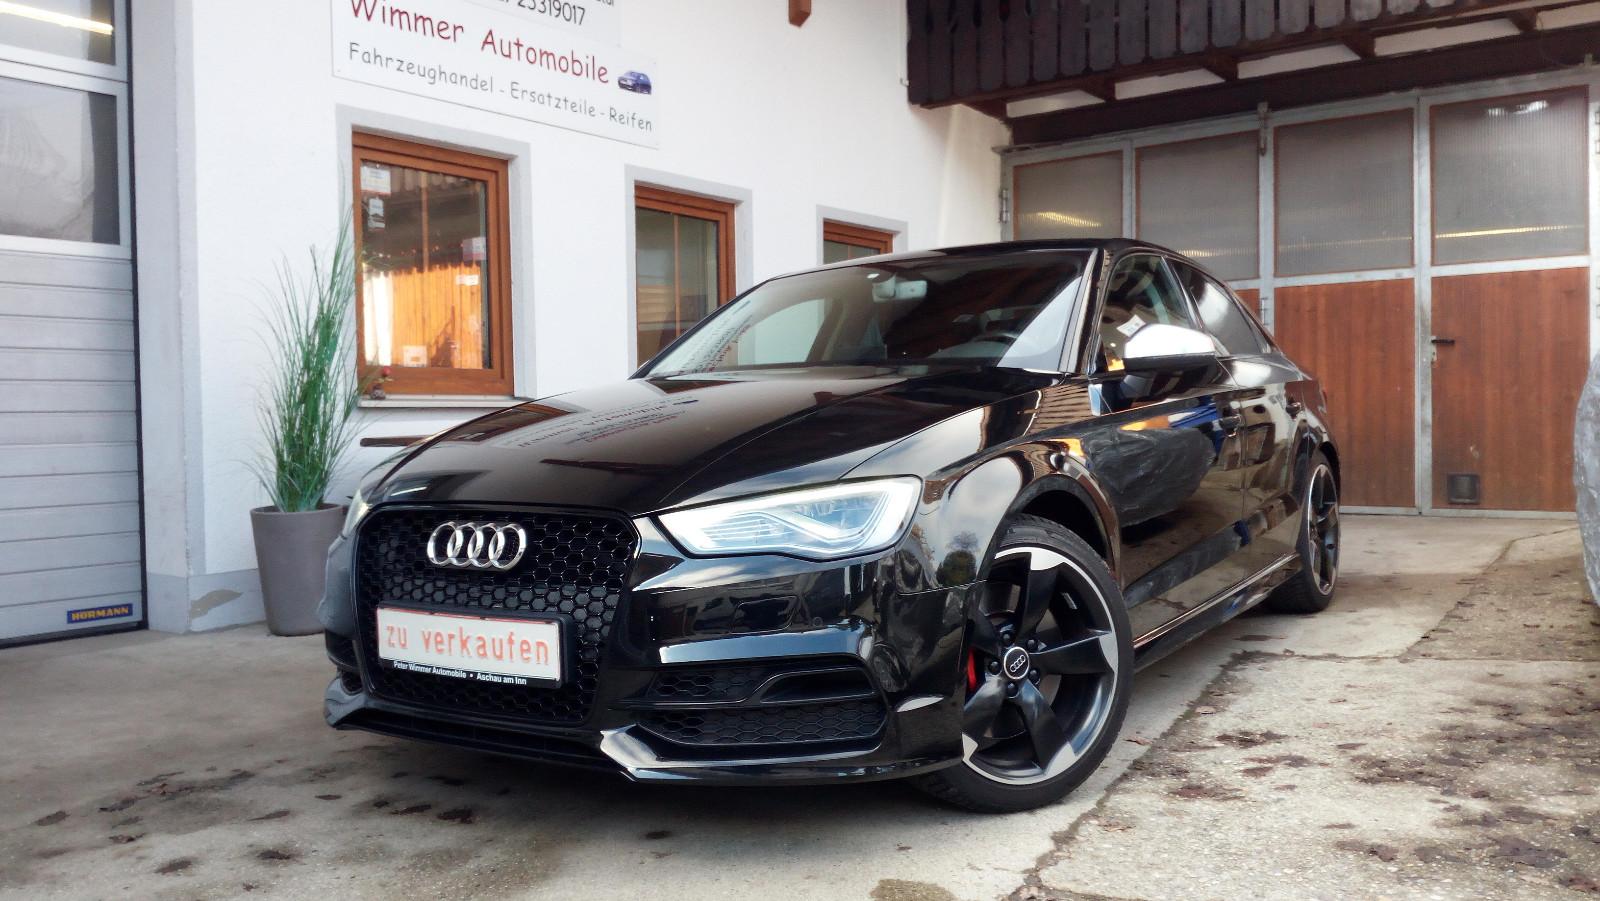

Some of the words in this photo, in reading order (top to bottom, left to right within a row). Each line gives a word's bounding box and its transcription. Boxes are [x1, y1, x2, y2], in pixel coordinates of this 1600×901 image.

[351, 0, 464, 42] Wimmer
[481, 29, 609, 84] Automobile
[349, 42, 493, 93] Fahrzeughandel
[510, 81, 596, 117] Ersatzteile
[609, 106, 652, 132] Reifen
[386, 624, 408, 650] zu
[421, 626, 550, 666] verkaufen
[393, 660, 408, 670] Peter
[409, 663, 432, 674] Wimmer
[432, 666, 467, 679] Automobile
[476, 672, 502, 683] Aschau
[503, 676, 514, 684] am
[515, 677, 527, 686] Inn
